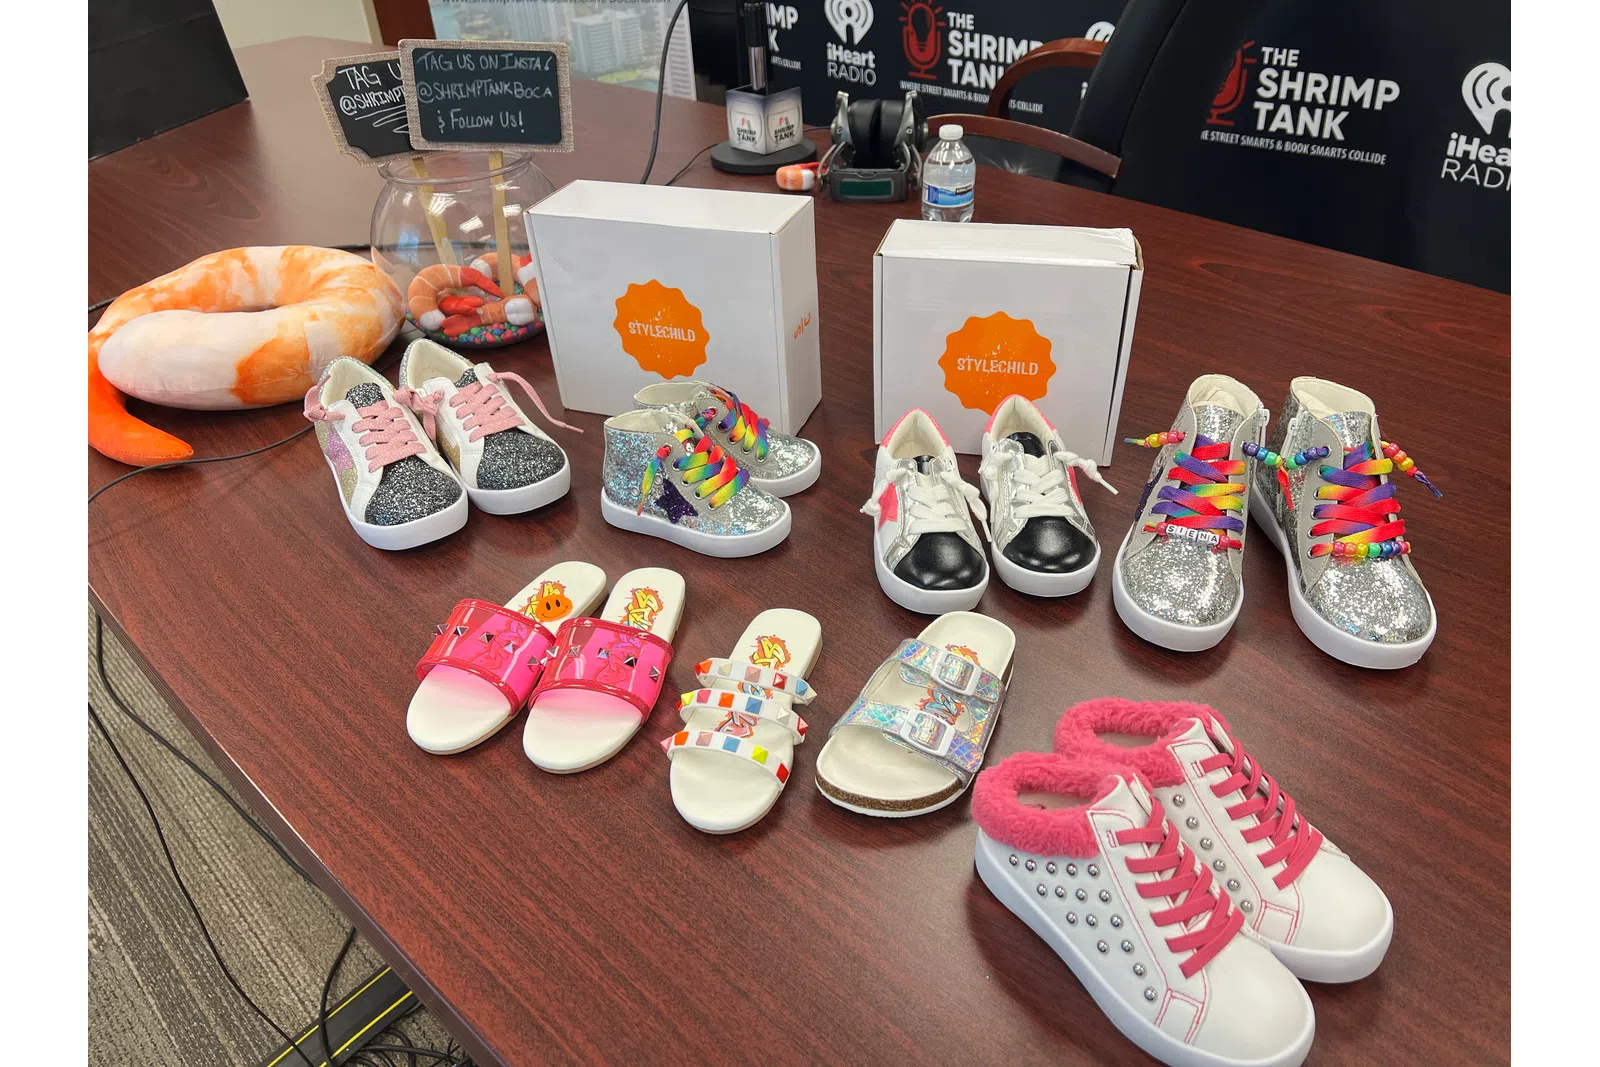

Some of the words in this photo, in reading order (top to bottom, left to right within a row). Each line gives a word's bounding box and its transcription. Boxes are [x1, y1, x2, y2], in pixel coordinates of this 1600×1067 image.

[765, 2, 799, 30] IMP
[947, 11, 975, 30] THE
[416, 51, 453, 71] TAG
[457, 54, 475, 71] US
[480, 54, 498, 70] ON
[826, 41, 876, 69] iHeart
[1261, 46, 1300, 68] THE
[337, 65, 382, 90] TAG
[387, 62, 403, 80] U
[827, 61, 877, 86] RADIO
[416, 79, 554, 104] @SHRIMPTANKBOCA
[922, 84, 942, 96] STREET
[943, 88, 967, 100] SMARTS
[1256, 67, 1401, 111] SHRIMP
[450, 108, 494, 131] FOLLOW
[500, 110, 525, 134] US!
[1253, 101, 1350, 141] TANK
[738, 133, 757, 146] TANK
[774, 131, 795, 145] TANK
[1210, 132, 1240, 145] STREET
[1240, 135, 1275, 150] SMARTS
[1275, 141, 1283, 151] &
[1284, 142, 1310, 155] BOOK
[1310, 144, 1348, 160] SMARTS
[1348, 149, 1387, 165] COLLIDE
[1446, 132, 1512, 167] iHea
[1440, 158, 1512, 192] RADI
[628, 320, 696, 343] STYLECHILD
[957, 357, 1039, 376] STYLECHILD
[1167, 526, 1218, 542] SIENA
